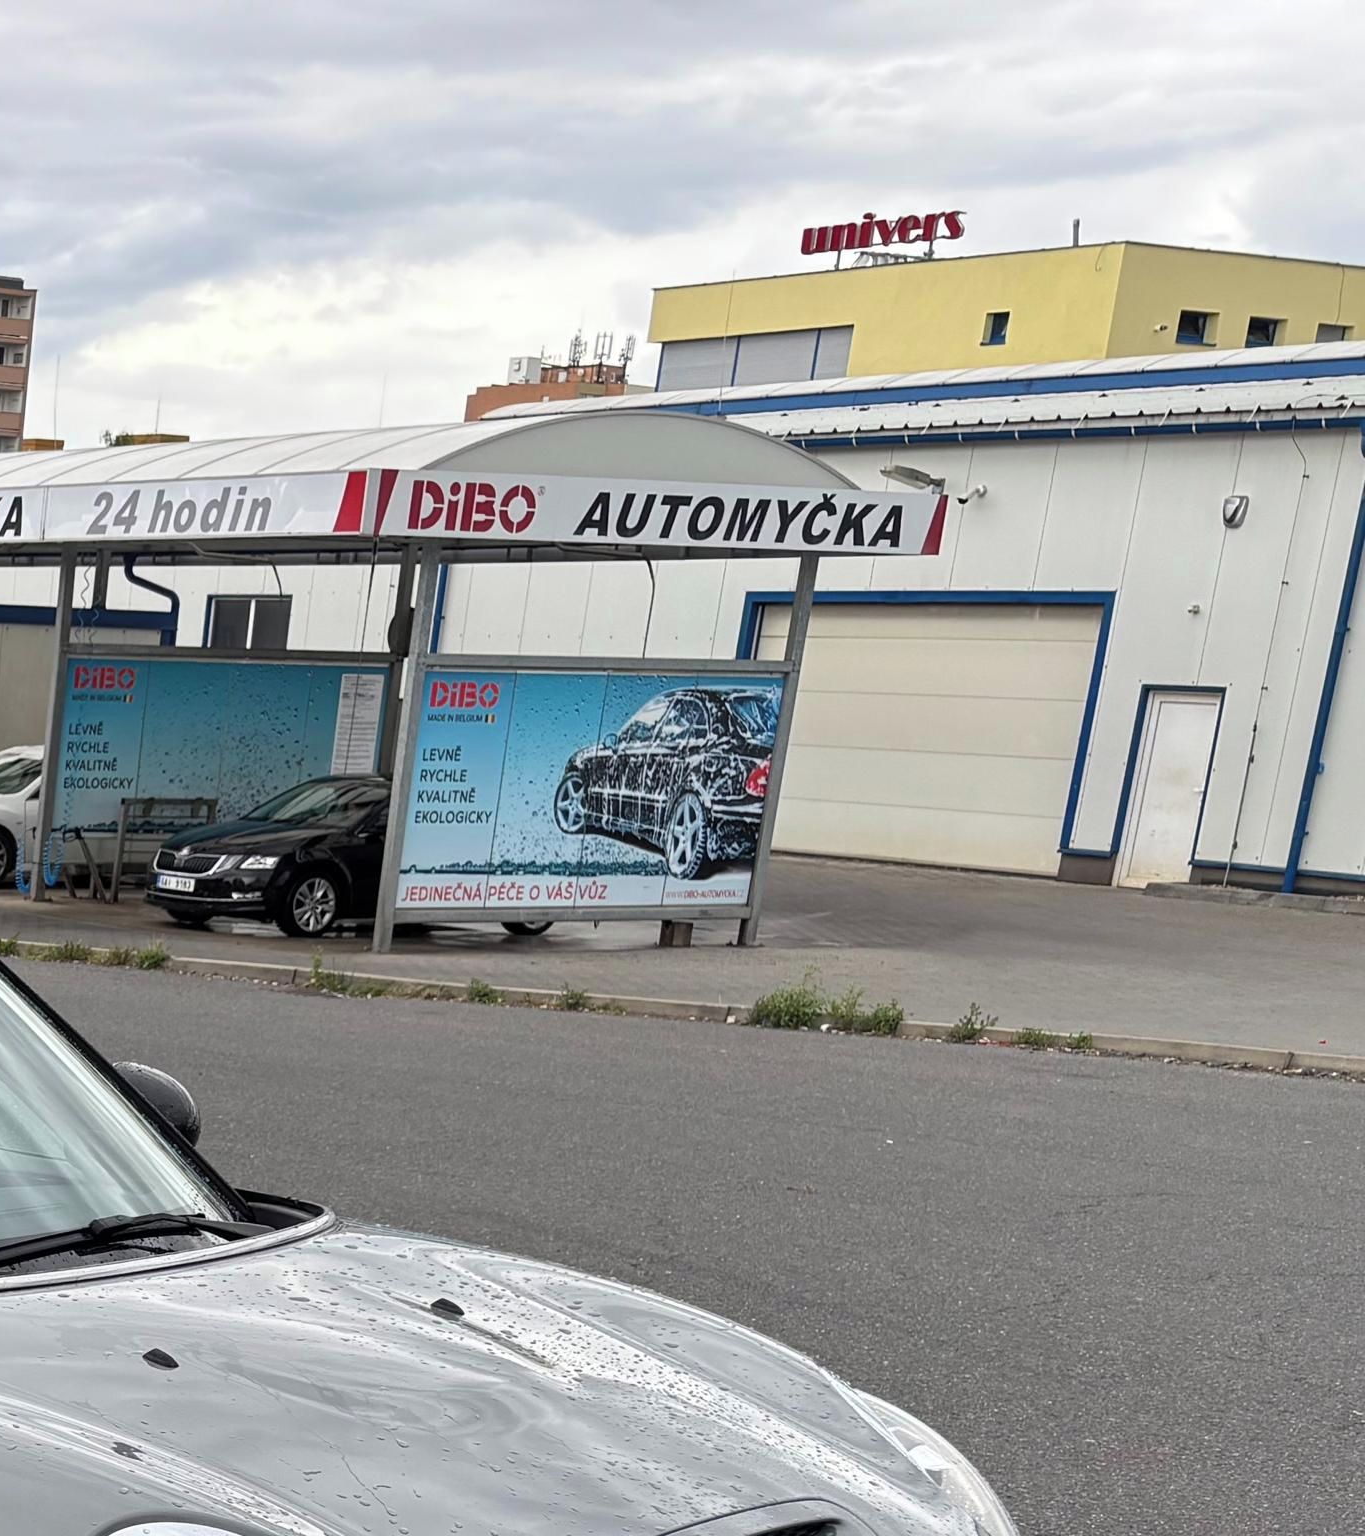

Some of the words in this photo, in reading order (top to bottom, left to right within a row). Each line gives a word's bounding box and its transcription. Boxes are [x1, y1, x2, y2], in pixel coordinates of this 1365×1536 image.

[801, 211, 967, 255] univers
[86, 489, 141, 535] 24
[147, 485, 272, 534] hodin
[573, 492, 904, 548] AUTOMYČKA
[427, 713, 445, 722] MADE
[447, 714, 454, 722] IN
[455, 714, 483, 723] BELGIUM
[68, 721, 103, 735] LEVNĚ
[66, 741, 110, 754] RYCHLE
[422, 745, 462, 762] LEVNĚ
[65, 757, 118, 772] KVALITNĚ
[63, 777, 134, 790] EKOLOGICKY
[419, 769, 468, 783] RYCHLE
[417, 787, 476, 804] KVALITNĚ
[414, 810, 493, 824] EKOLOGICKY
[402, 881, 482, 902] JEDINEČNÁ
[487, 881, 524, 901] PÉČE
[529, 885, 540, 900] O
[545, 880, 574, 900] VÁŠ
[578, 880, 607, 900] VŮZ
